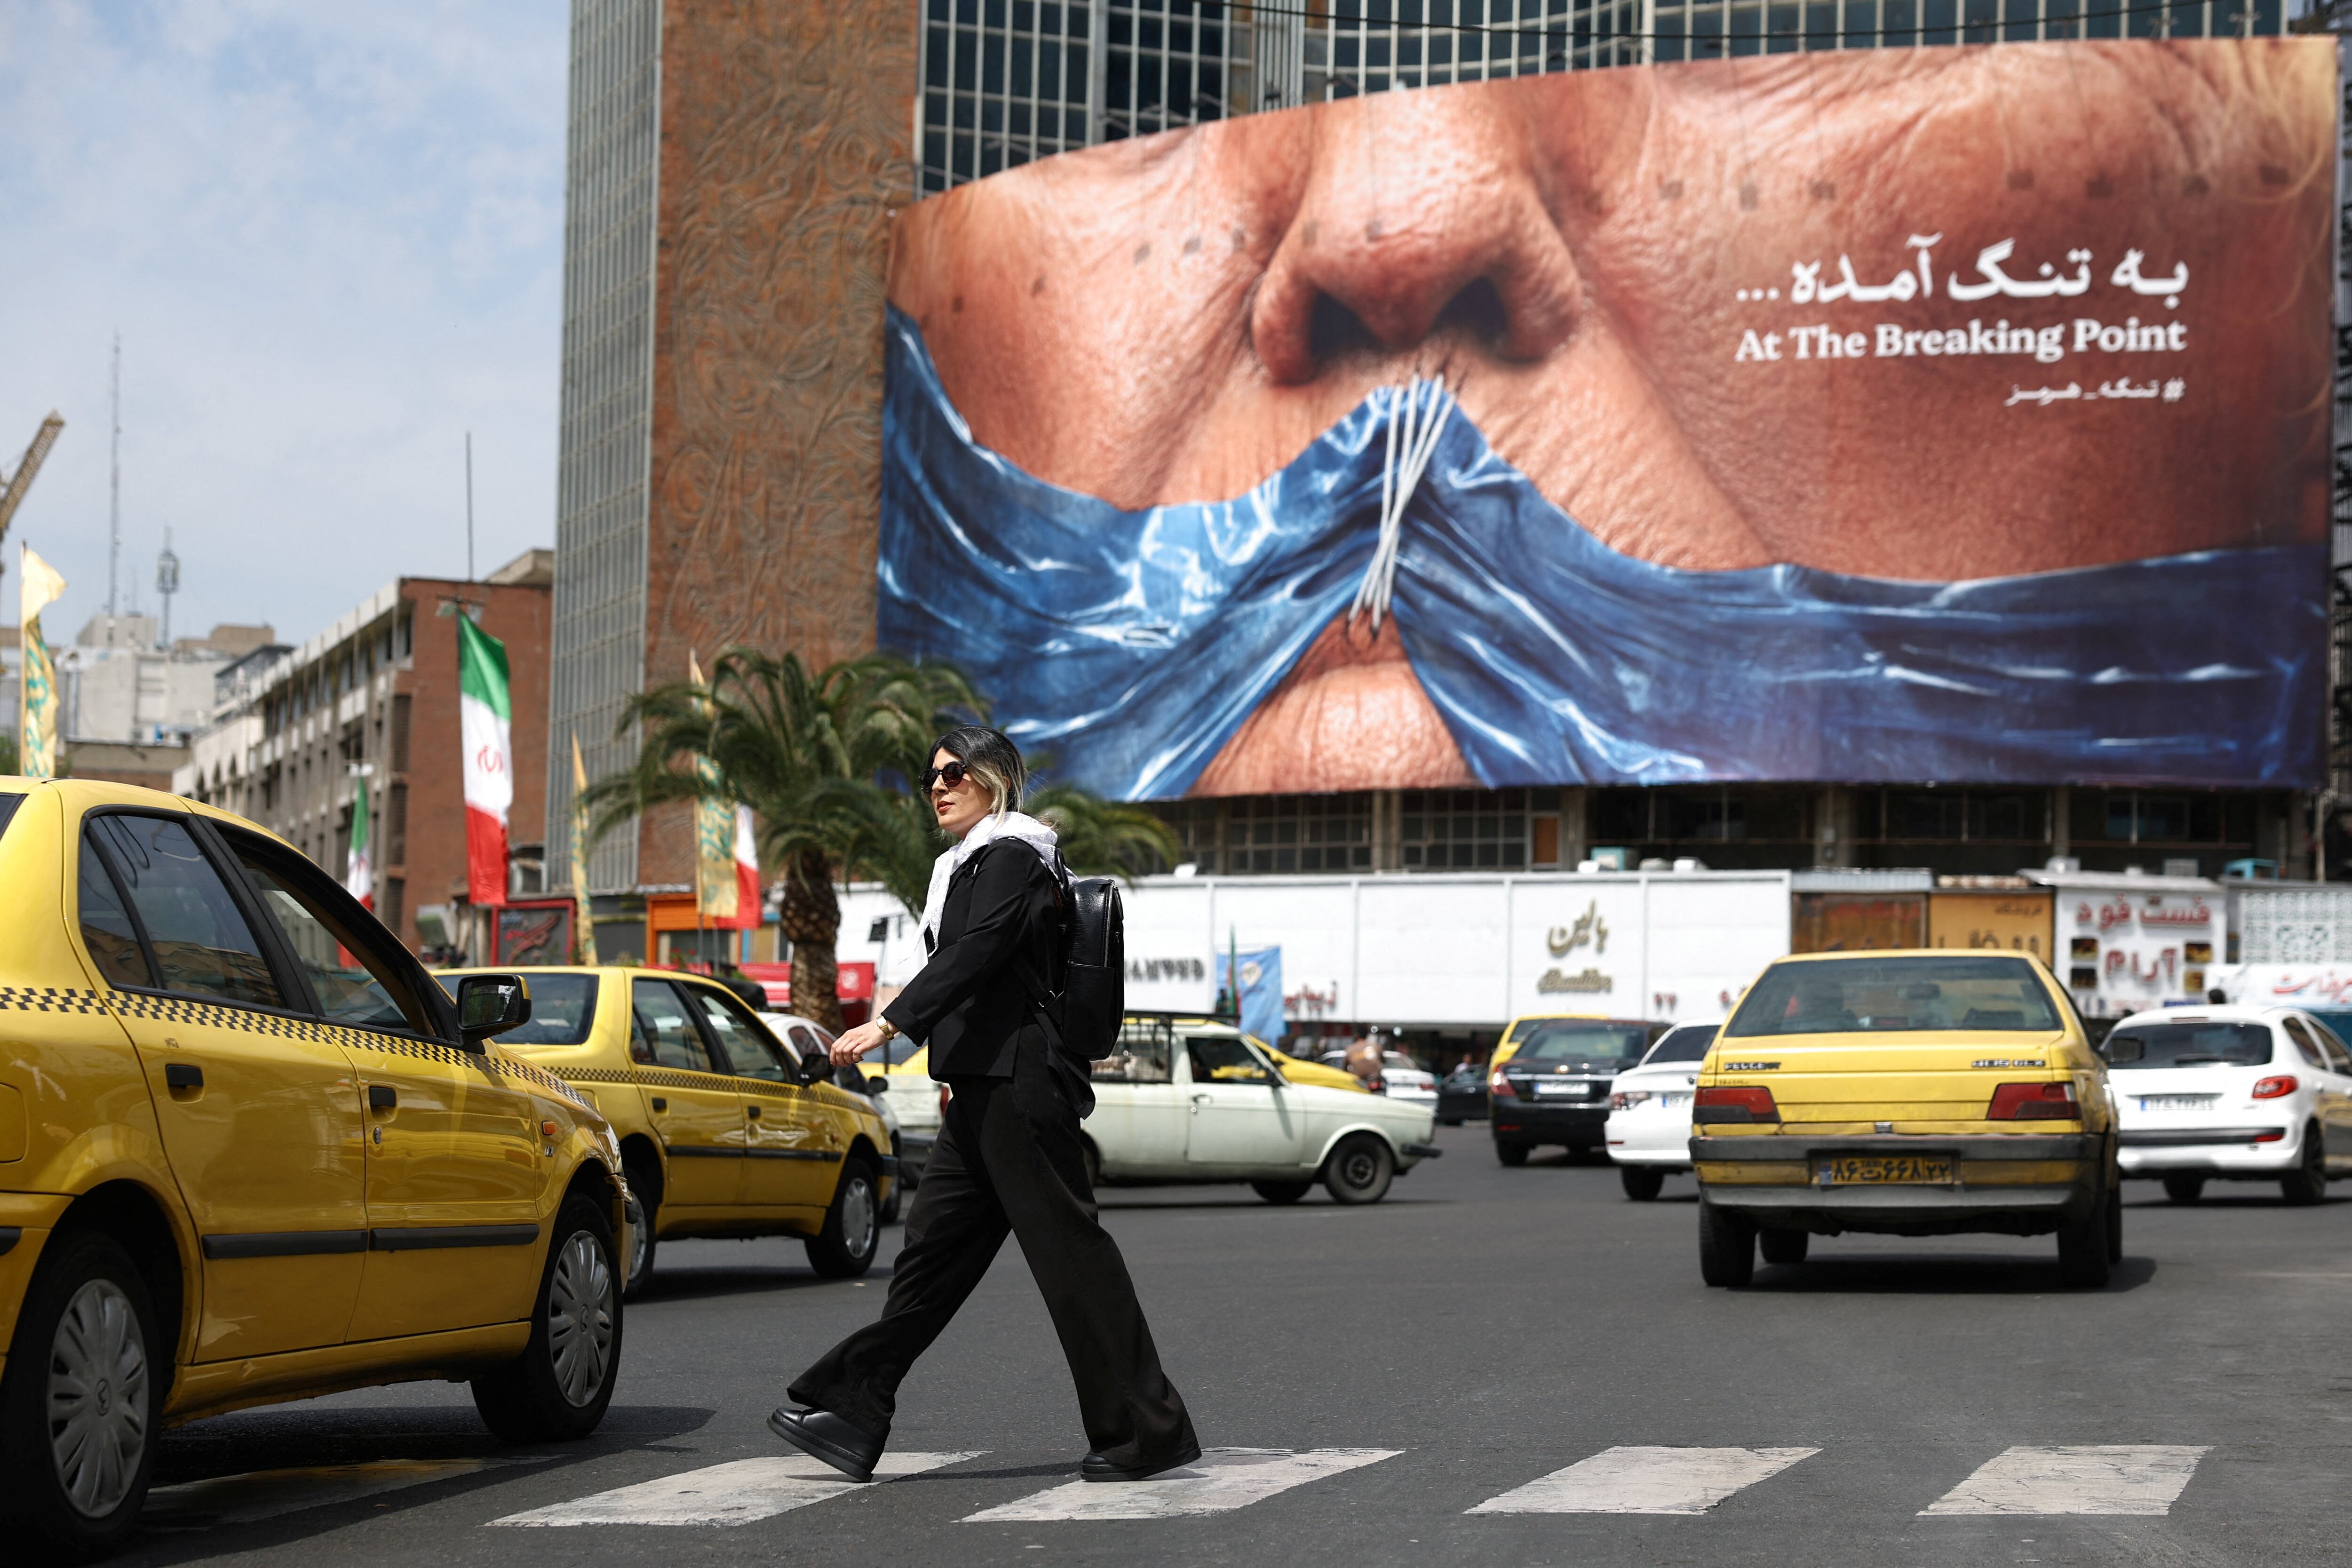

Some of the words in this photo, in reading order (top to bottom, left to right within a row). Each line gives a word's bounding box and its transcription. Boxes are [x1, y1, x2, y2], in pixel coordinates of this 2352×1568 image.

[1790, 231, 1943, 304] آمده
[1947, 236, 2094, 302] تنگ
[2110, 247, 2190, 310] به
[1734, 328, 1782, 361] At
[1788, 323, 1868, 359] The
[1874, 317, 2065, 363] Breaking
[2072, 316, 2188, 352] Point
[2076, 892, 2131, 931] فود
[2139, 894, 2211, 926] فست
[2106, 947, 2177, 982] آرام
